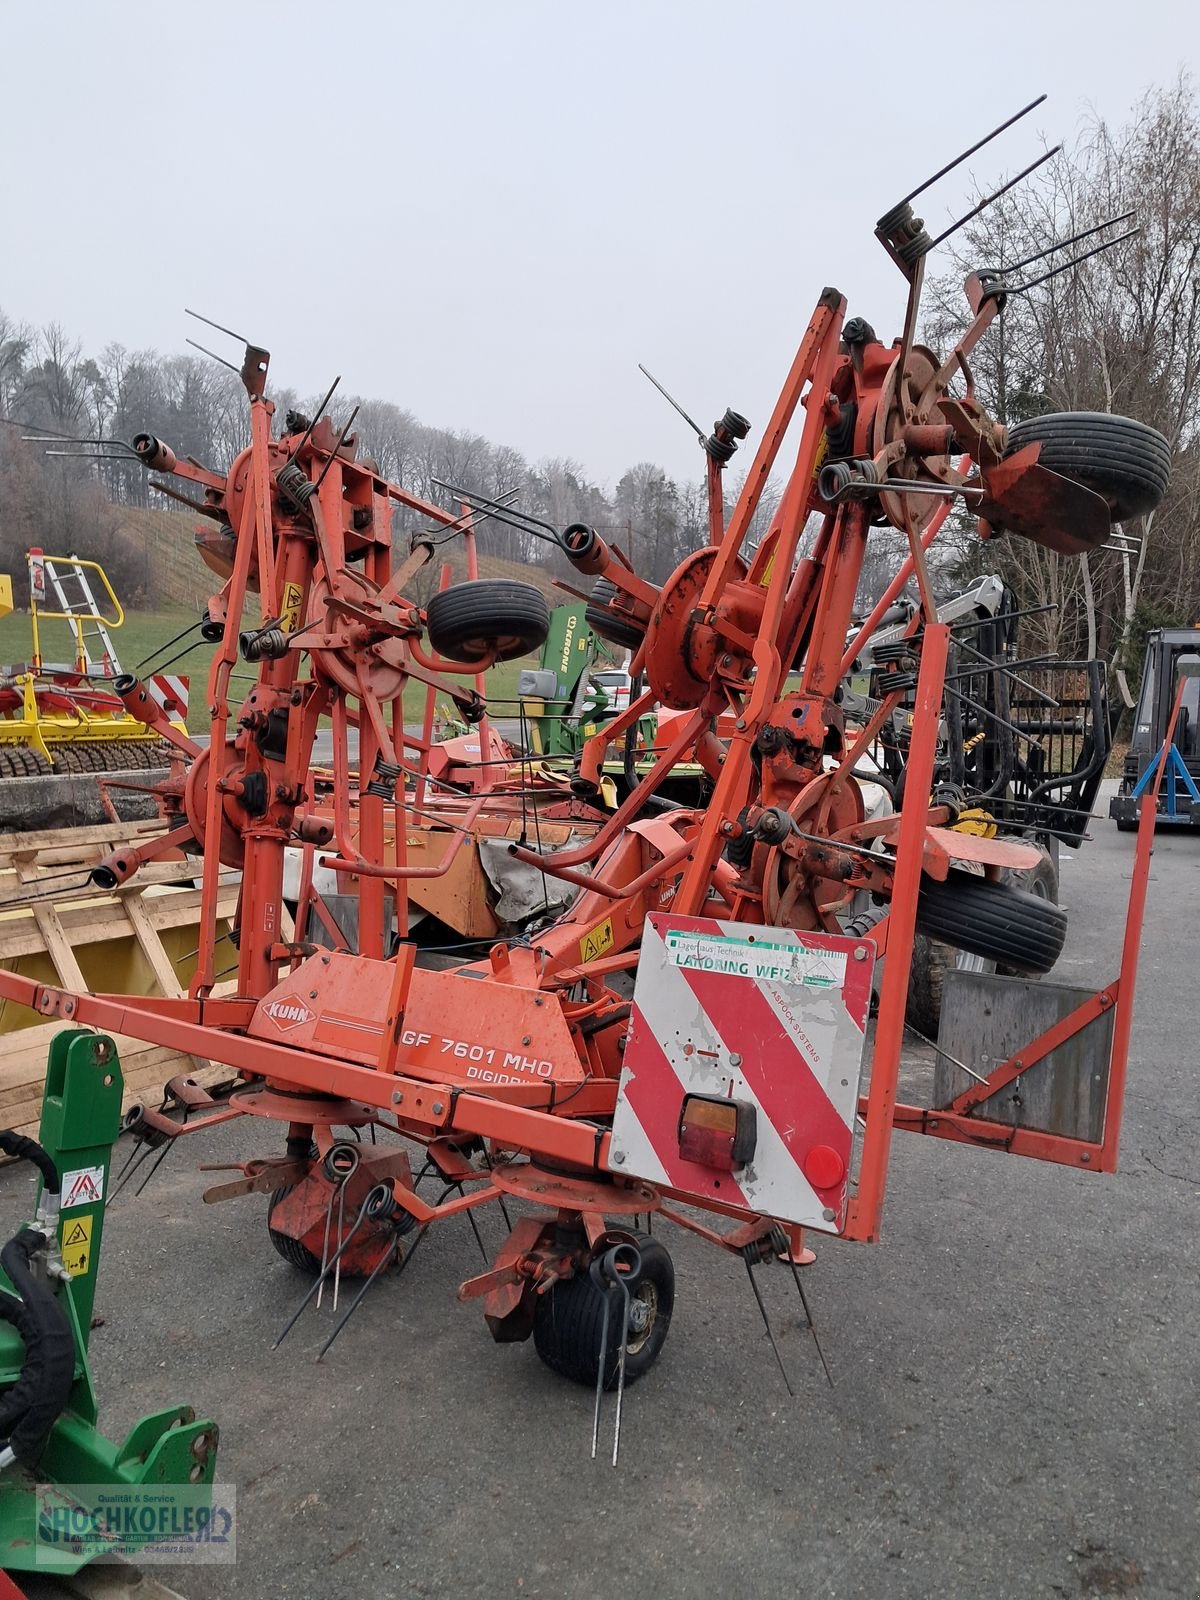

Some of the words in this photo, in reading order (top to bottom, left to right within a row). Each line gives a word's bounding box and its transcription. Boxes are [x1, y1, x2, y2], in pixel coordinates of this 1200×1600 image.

[560, 629, 573, 673] KRONE
[659, 886, 676, 904] UHN
[717, 945, 745, 957] Technik
[268, 1002, 310, 1022] KUHN
[401, 1029, 431, 1046] GF
[440, 1037, 495, 1064] 7601
[502, 1052, 553, 1078] MHO
[793, 1022, 820, 1063] SYSTEMS
